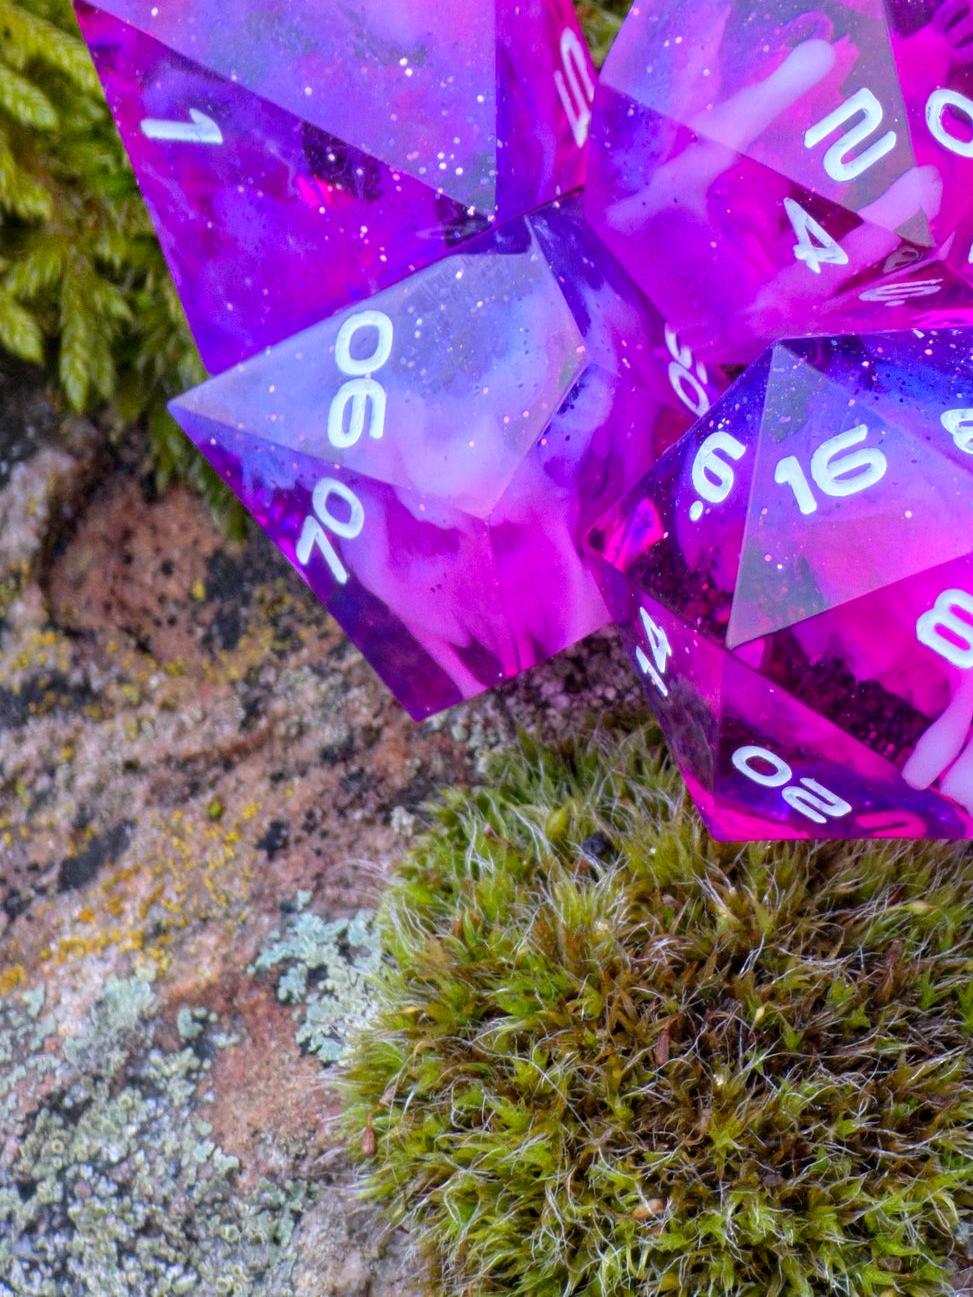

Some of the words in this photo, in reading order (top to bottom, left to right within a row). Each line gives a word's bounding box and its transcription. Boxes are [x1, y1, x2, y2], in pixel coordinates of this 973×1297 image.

[140, 108, 223, 144] 1
[804, 87, 897, 183] 2
[784, 198, 849, 274] 4
[774, 423, 888, 516] 16
[296, 477, 365, 585] 70
[636, 606, 672, 697] 14
[731, 745, 852, 824] 20
